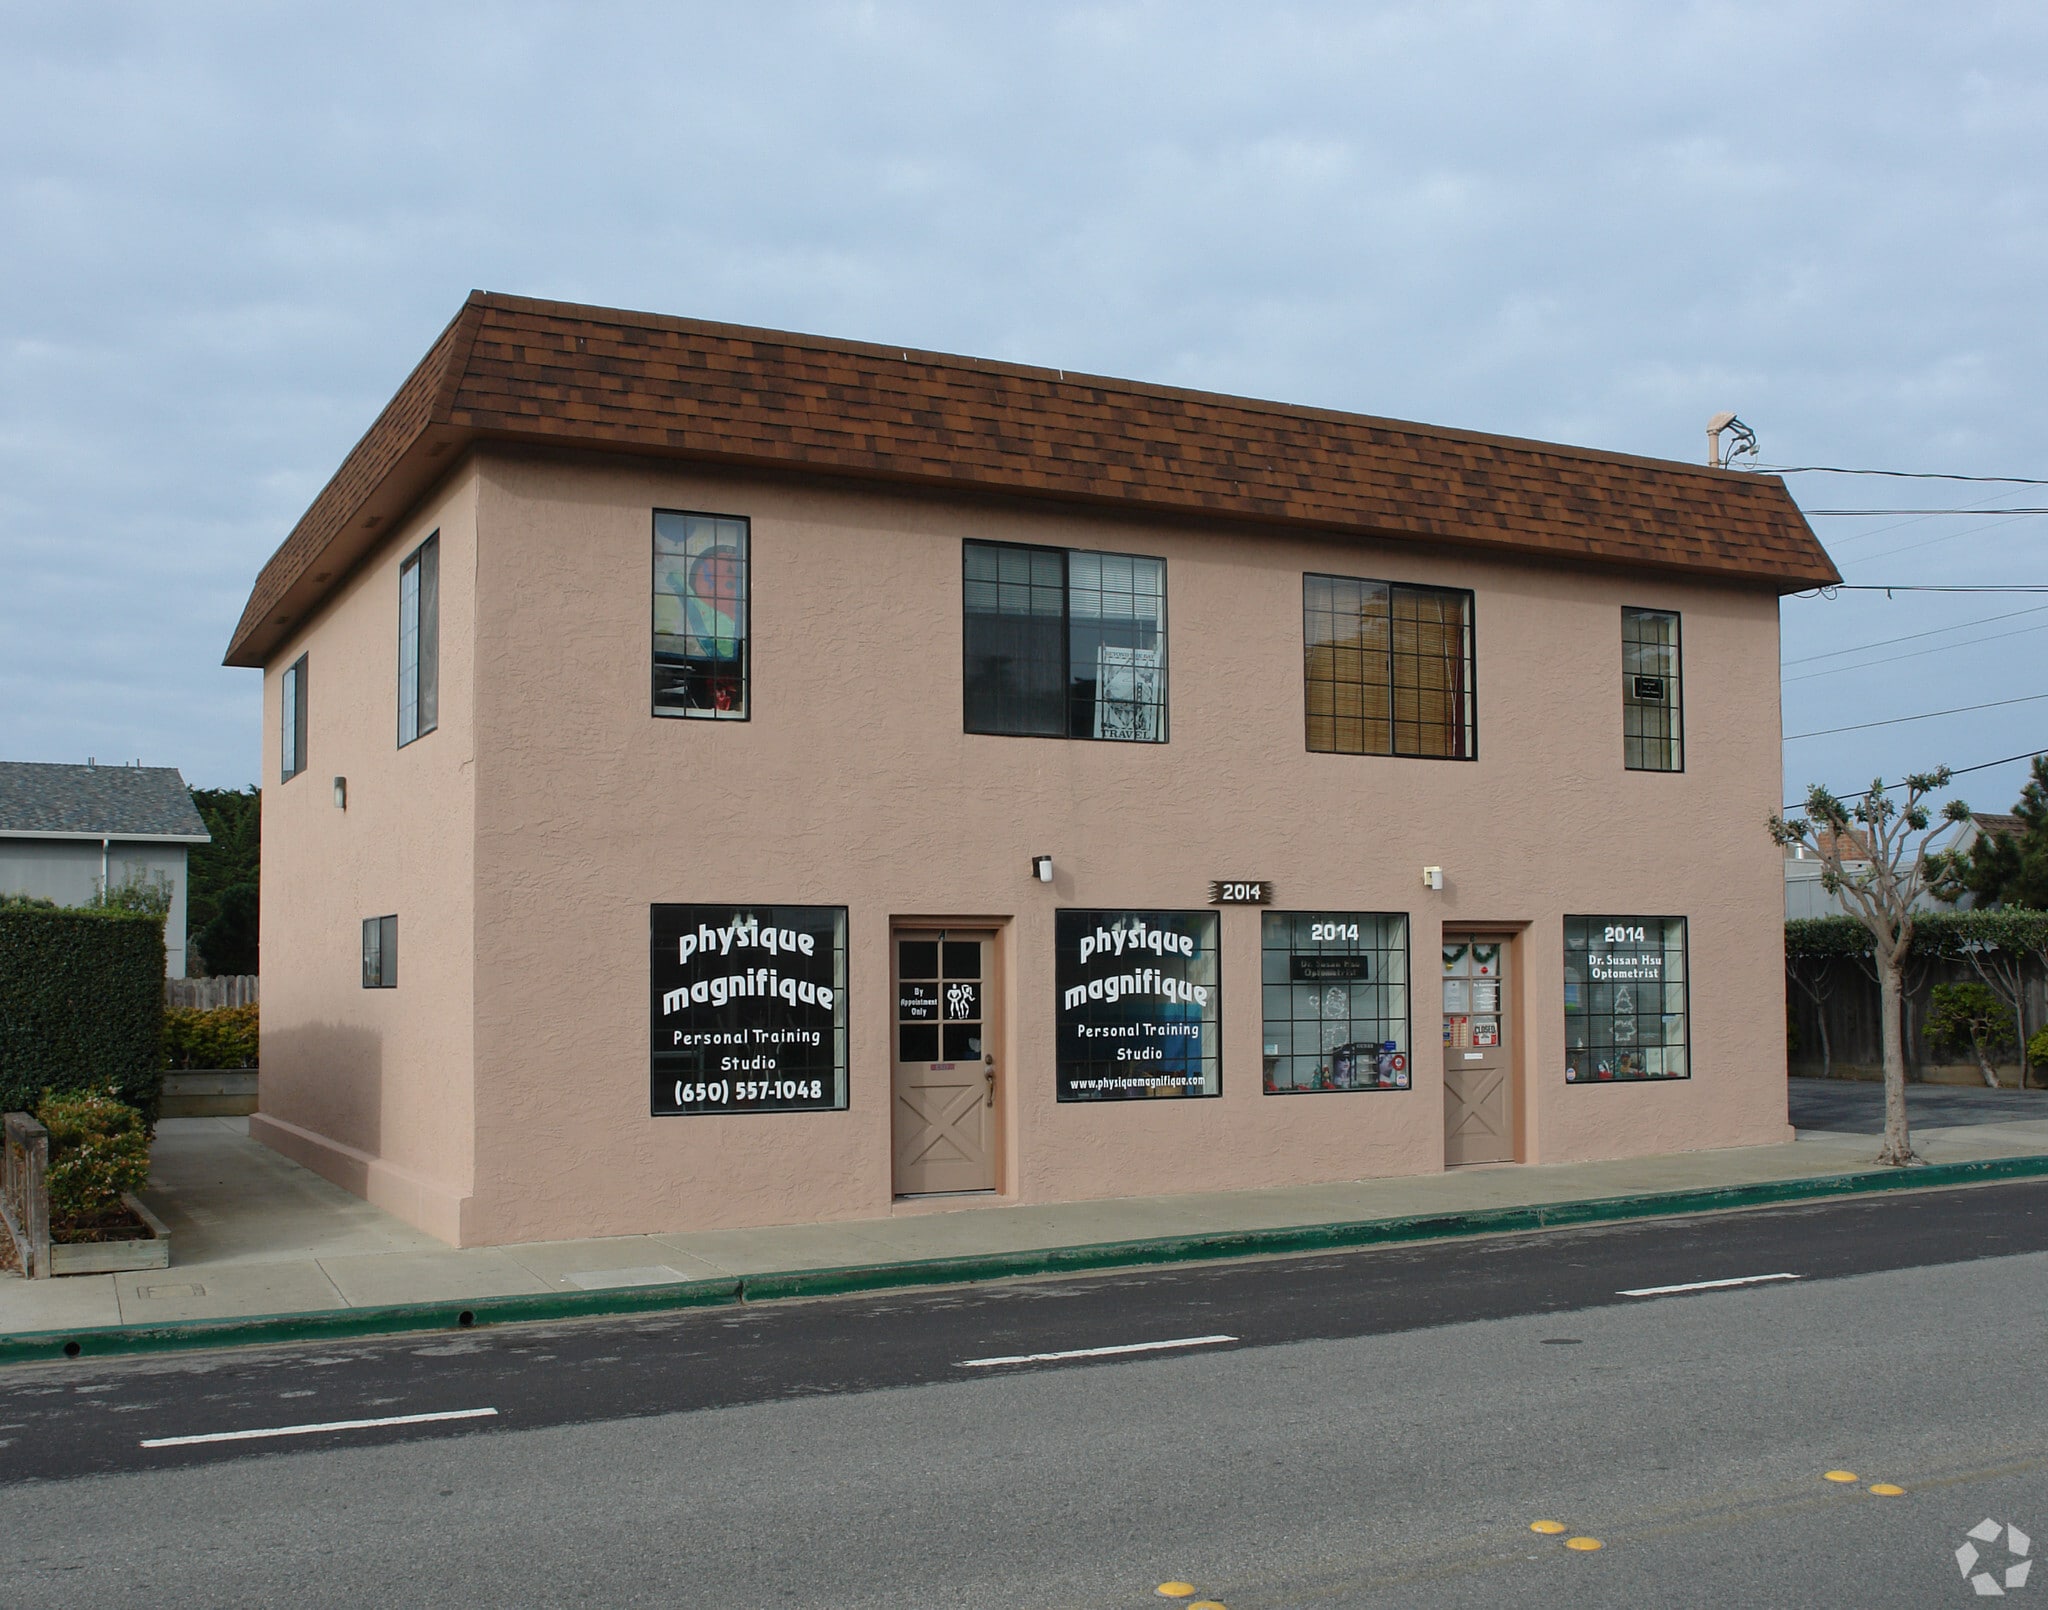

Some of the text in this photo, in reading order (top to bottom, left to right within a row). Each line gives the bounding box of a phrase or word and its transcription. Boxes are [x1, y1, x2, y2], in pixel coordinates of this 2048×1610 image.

[1101, 729, 1151, 740] TRAVEL
[1222, 884, 1261, 900] 2014
[1311, 923, 1360, 941] 2014
[1604, 926, 1645, 942] 2014
[679, 919, 815, 965] physique
[1080, 923, 1193, 964] physique
[1589, 954, 1662, 966] Dr. Susan Hsu
[1592, 967, 1659, 980] Optometrist
[663, 968, 834, 1016] magnifique
[914, 987, 924, 997] By
[1065, 968, 1208, 1011] magnifique
[900, 998, 938, 1007] Appointment
[911, 1007, 927, 1017] Only
[673, 1028, 821, 1046] Personal Training
[1078, 1022, 1199, 1039] Personal Training
[1116, 1047, 1163, 1061] Studio
[720, 1055, 776, 1071] Studio
[1070, 1075, 1205, 1091] www.physiquemagnifique.com
[674, 1079, 822, 1105] (650) 557-1048
